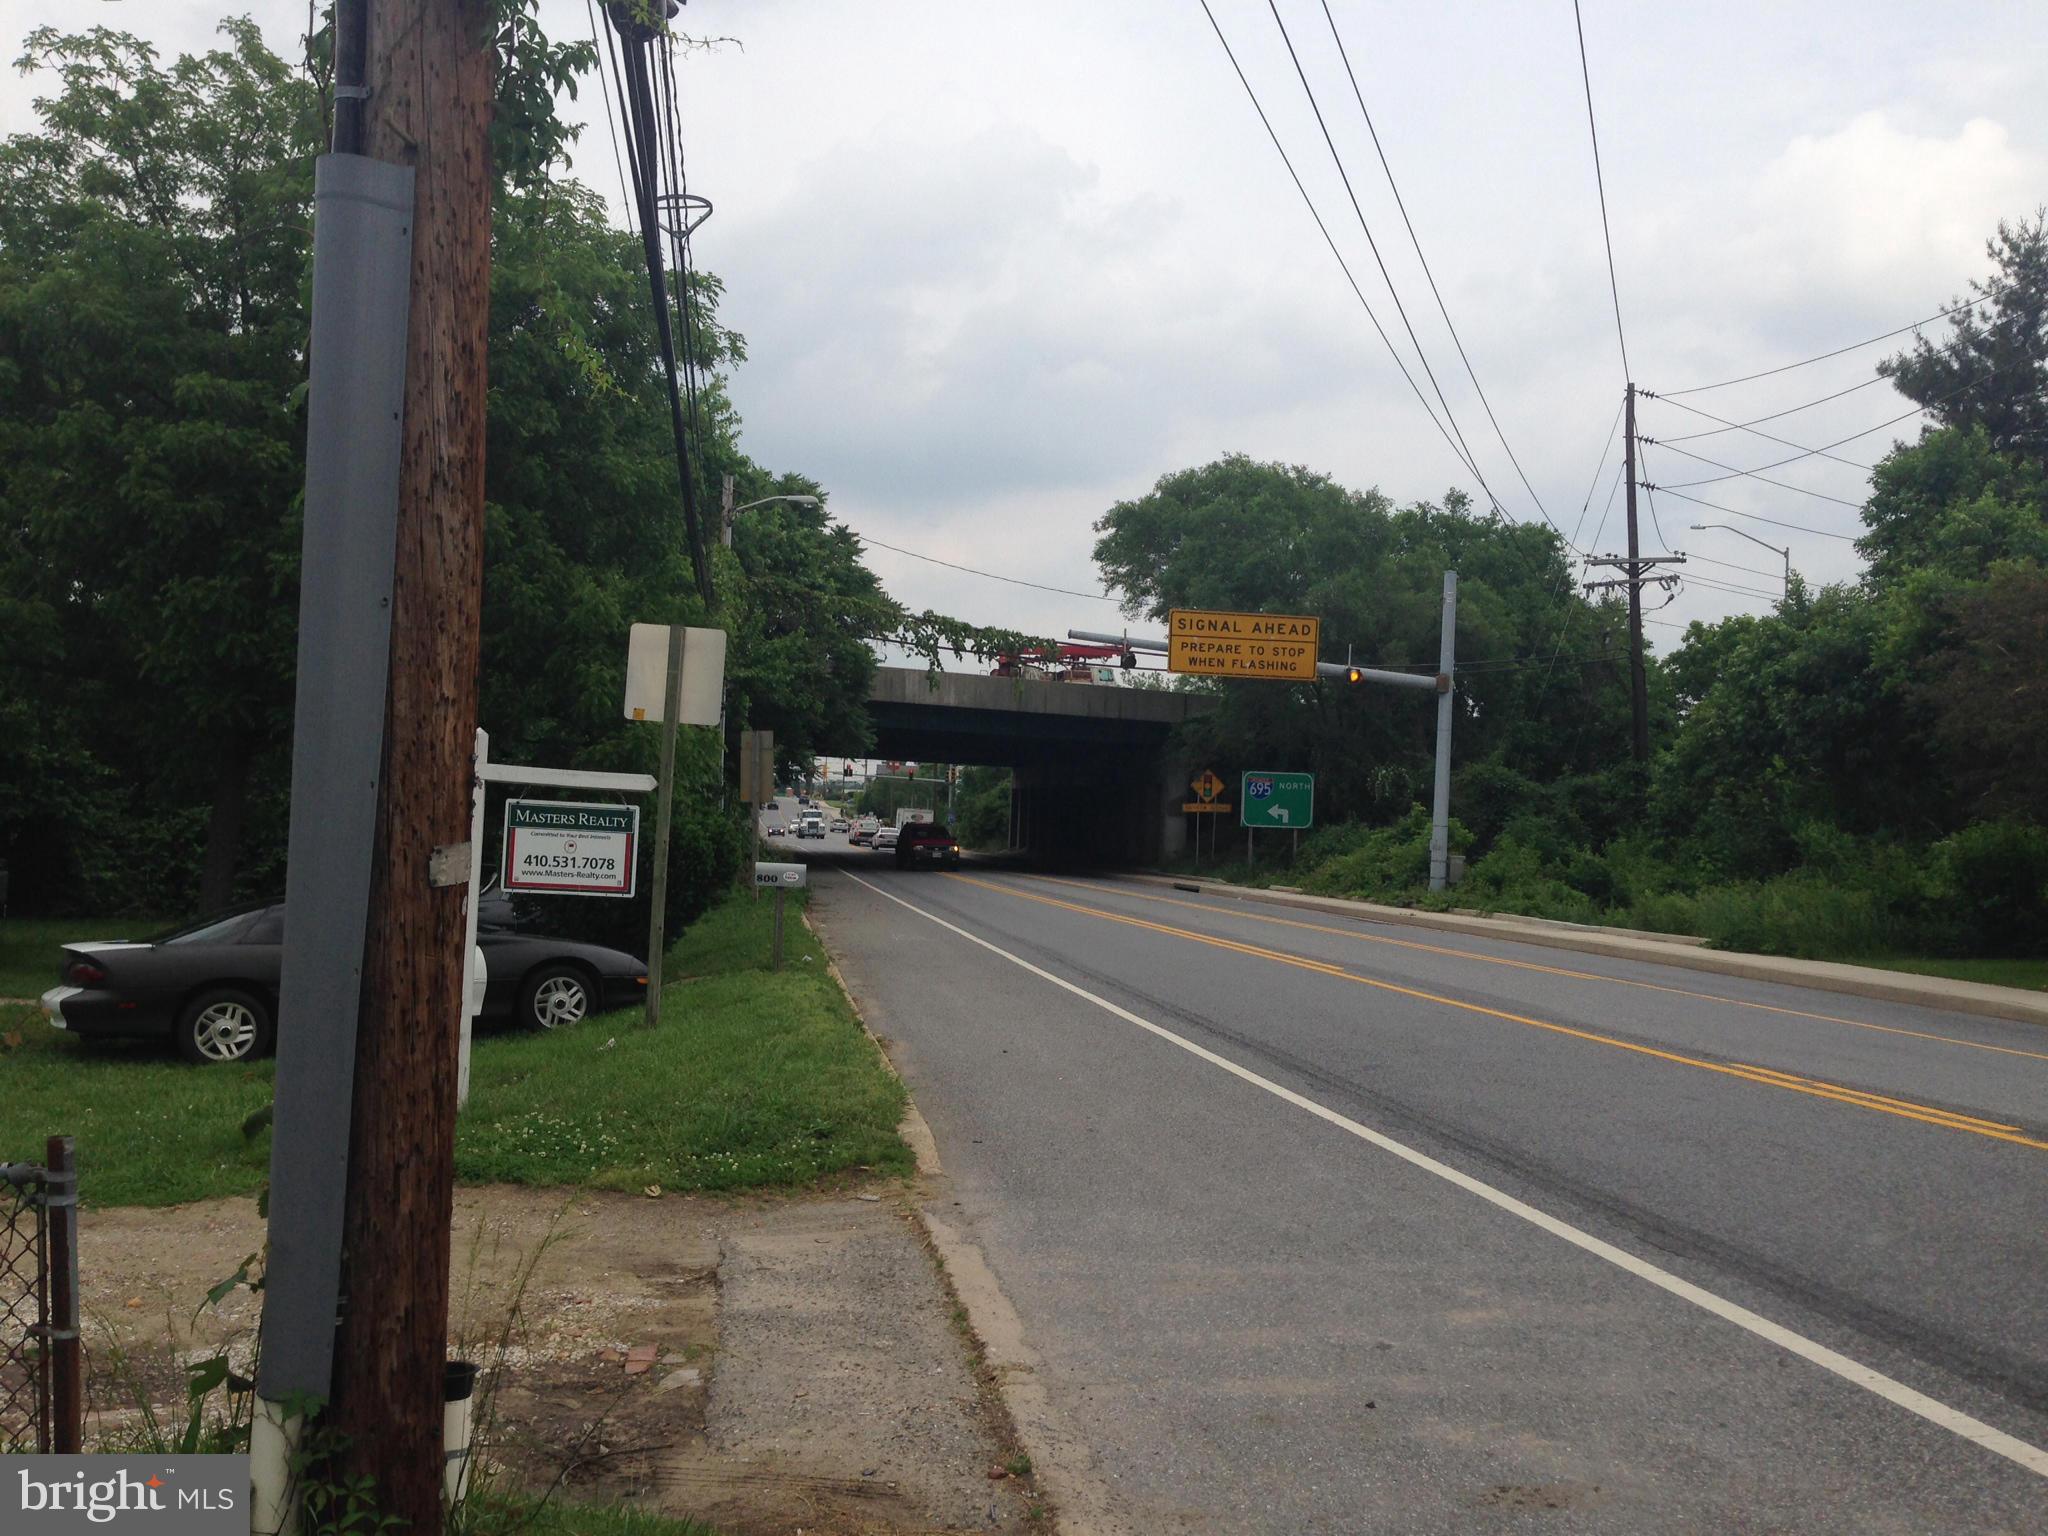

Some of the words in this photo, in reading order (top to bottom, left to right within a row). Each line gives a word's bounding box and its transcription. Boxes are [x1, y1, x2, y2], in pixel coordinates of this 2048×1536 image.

[1178, 618, 1241, 633] SIGNAL
[1252, 622, 1311, 636] AHEAD
[1181, 642, 1241, 655] PREPARE
[1249, 646, 1264, 656] TO
[1273, 647, 1305, 657] STOP
[1188, 657, 1225, 667] WHEN
[1232, 659, 1297, 671] FLASHING
[1250, 784, 1271, 796] 695
[1279, 782, 1311, 790] NORTH
[524, 854, 615, 870] 410.531.7078
[521, 869, 616, 880] www.Masters-Realty.com
[757, 874, 777, 882] 800
